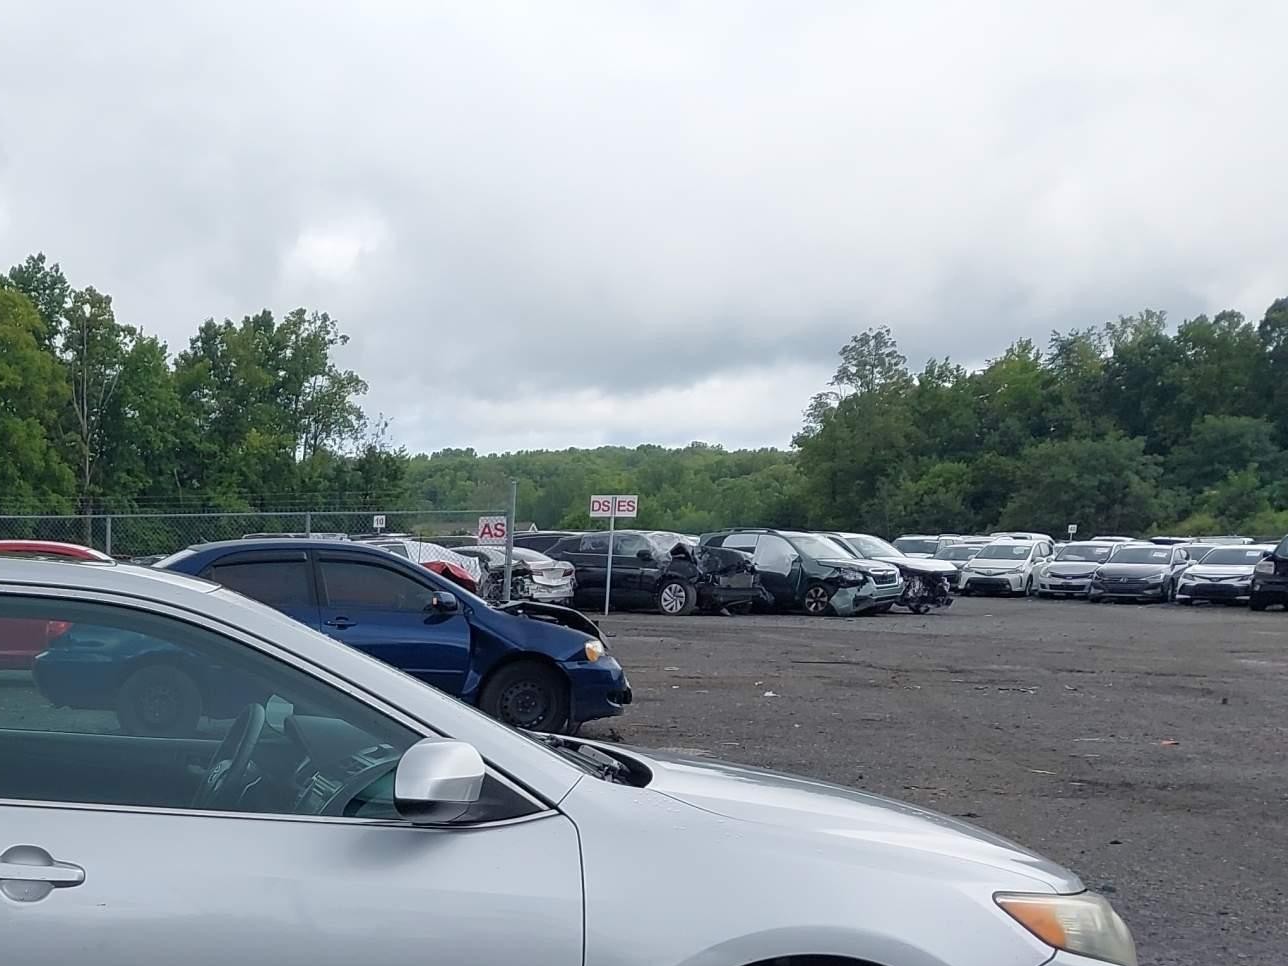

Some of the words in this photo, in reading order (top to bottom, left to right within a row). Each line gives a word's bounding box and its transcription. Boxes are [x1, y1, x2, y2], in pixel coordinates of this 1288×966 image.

[591, 501, 610, 512] DS
[617, 500, 636, 512] ES
[479, 523, 505, 538] AS
